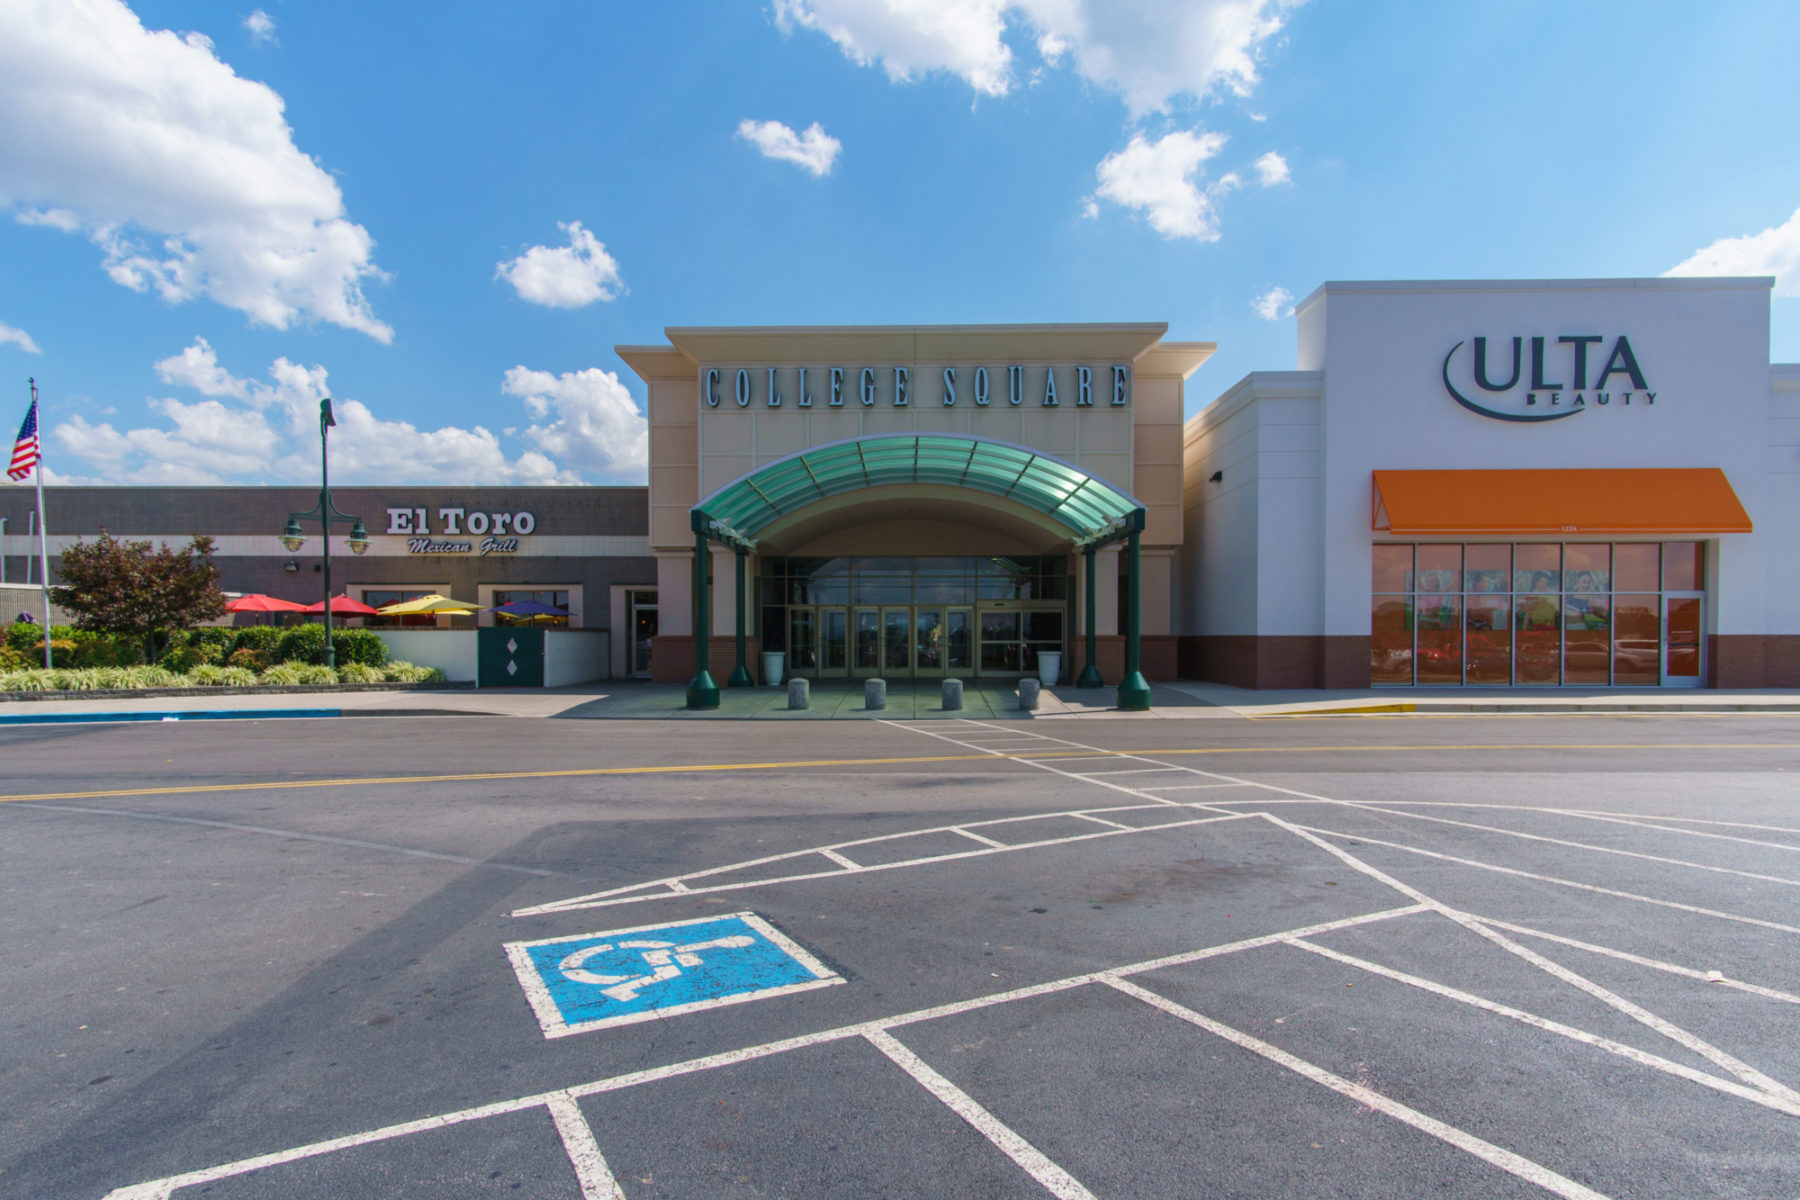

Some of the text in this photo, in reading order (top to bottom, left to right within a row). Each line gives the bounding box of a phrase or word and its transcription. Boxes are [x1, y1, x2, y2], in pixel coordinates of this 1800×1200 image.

[1474, 336, 1649, 392] ULTA
[706, 366, 1128, 408] COLLEGE SQUARE
[1526, 393, 1657, 405] BEAUTY
[386, 508, 535, 535] El Toro
[408, 537, 518, 556] Mexican Grill
